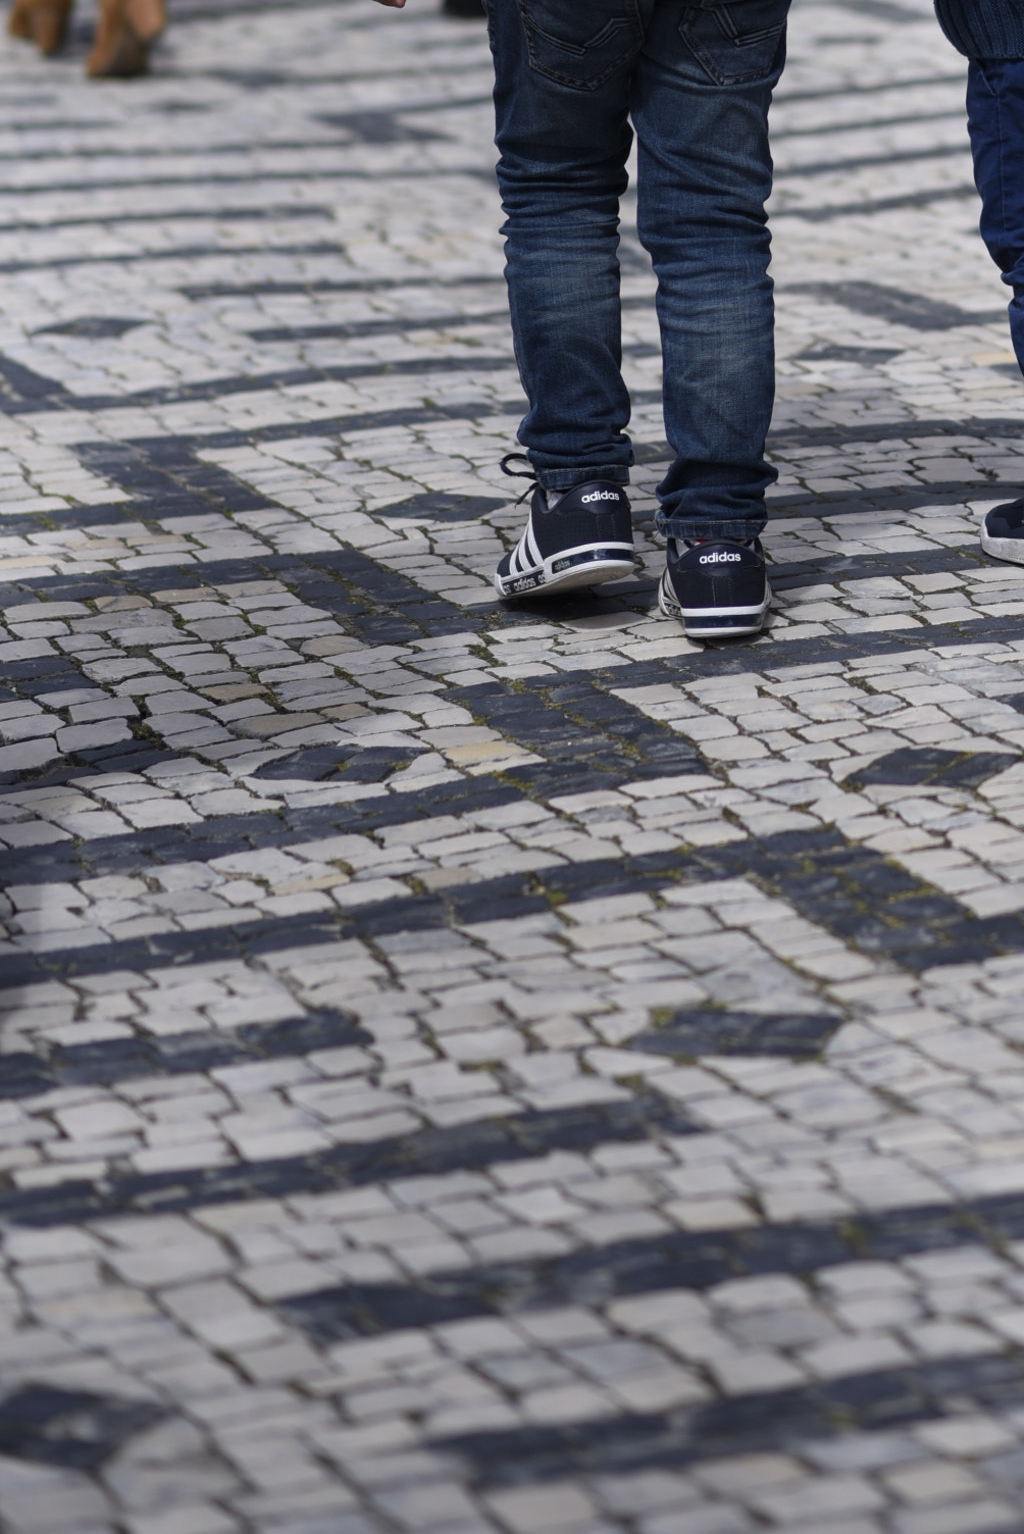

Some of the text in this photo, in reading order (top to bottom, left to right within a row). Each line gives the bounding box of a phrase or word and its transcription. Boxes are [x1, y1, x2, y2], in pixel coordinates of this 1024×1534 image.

[581, 490, 620, 504] adidas
[699, 552, 741, 564] adidas
[513, 577, 537, 592] adidas
